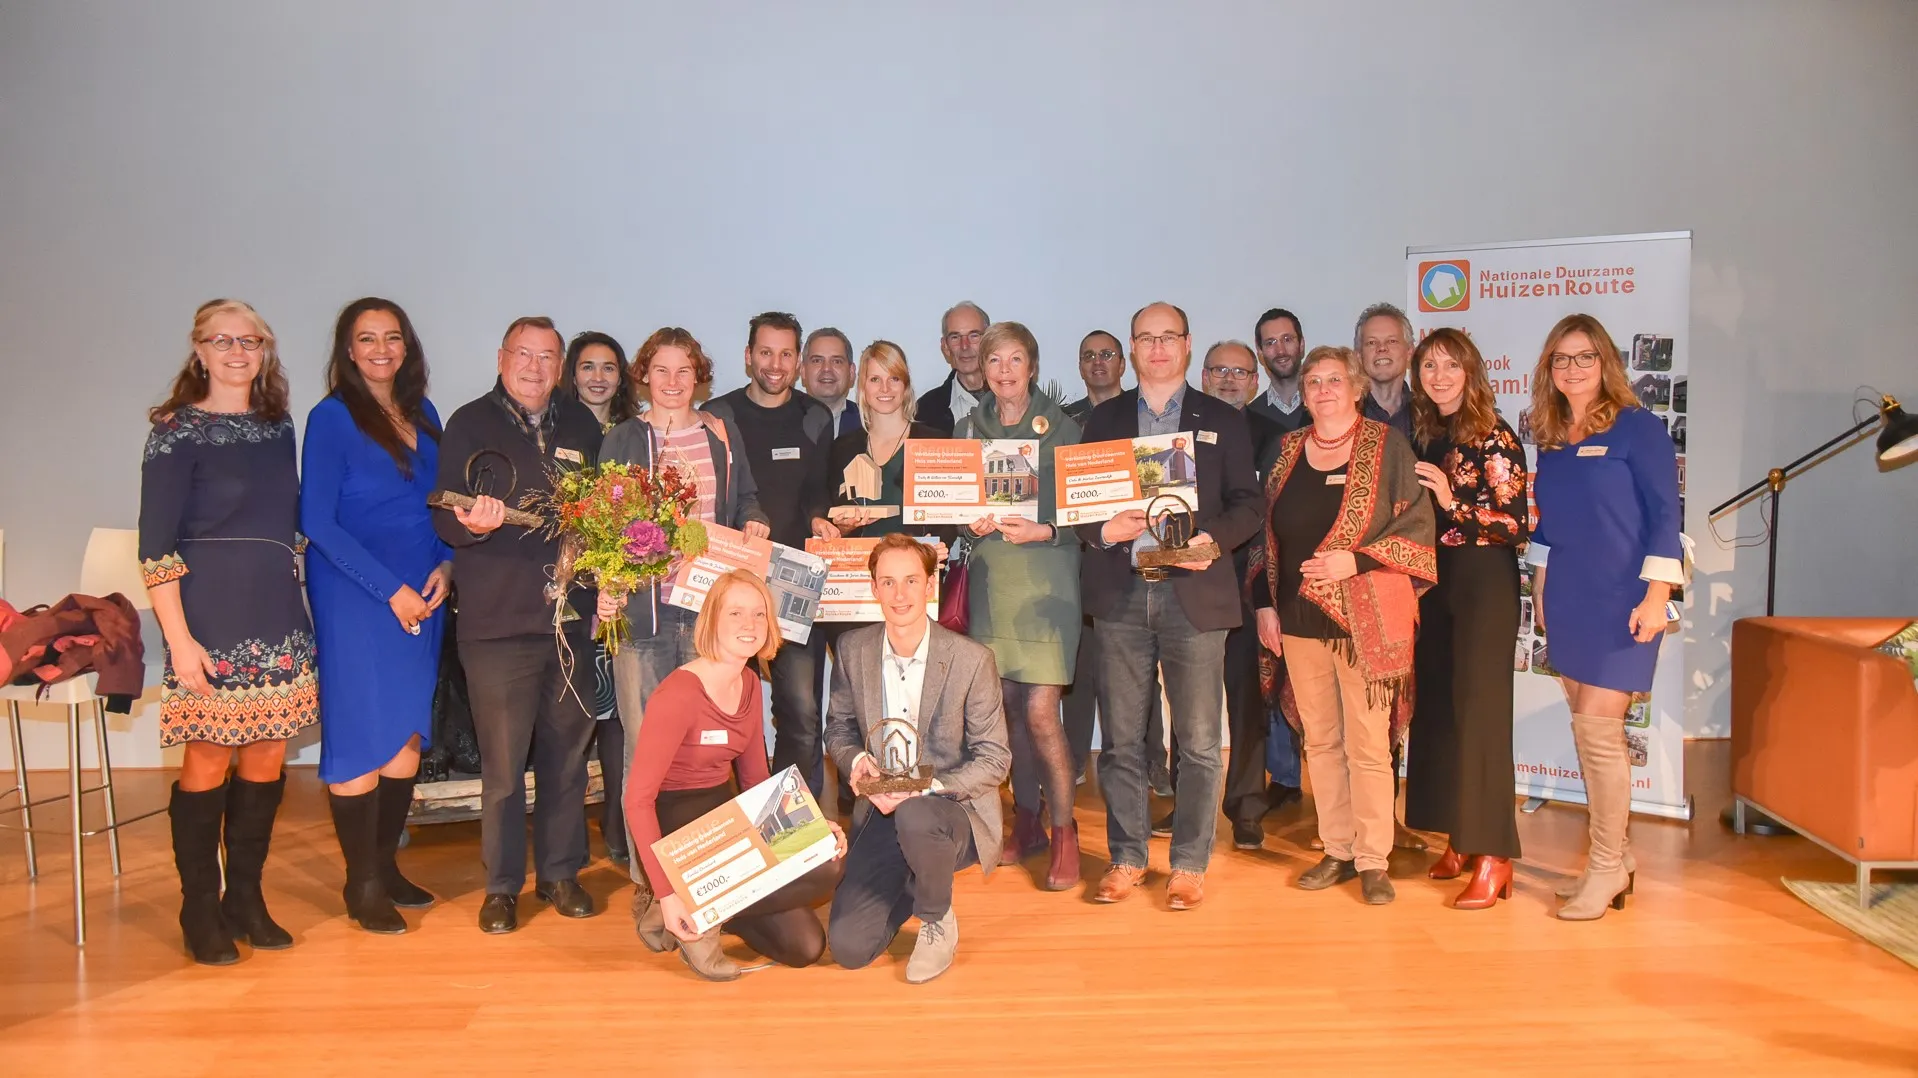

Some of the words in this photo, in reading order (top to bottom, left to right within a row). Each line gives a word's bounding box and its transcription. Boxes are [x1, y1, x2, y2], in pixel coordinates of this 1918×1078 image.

[1480, 269, 1551, 282] Nationale
[1556, 266, 1635, 279] Duurzame
[1486, 355, 1511, 370] ook
[1488, 374, 1528, 394] am!
[918, 489, 949, 498] €1000,-
[1070, 489, 1102, 500] €1000,-
[692, 574, 715, 586] €100
[822, 587, 844, 596] 500,-
[696, 874, 731, 897] €1000,-
